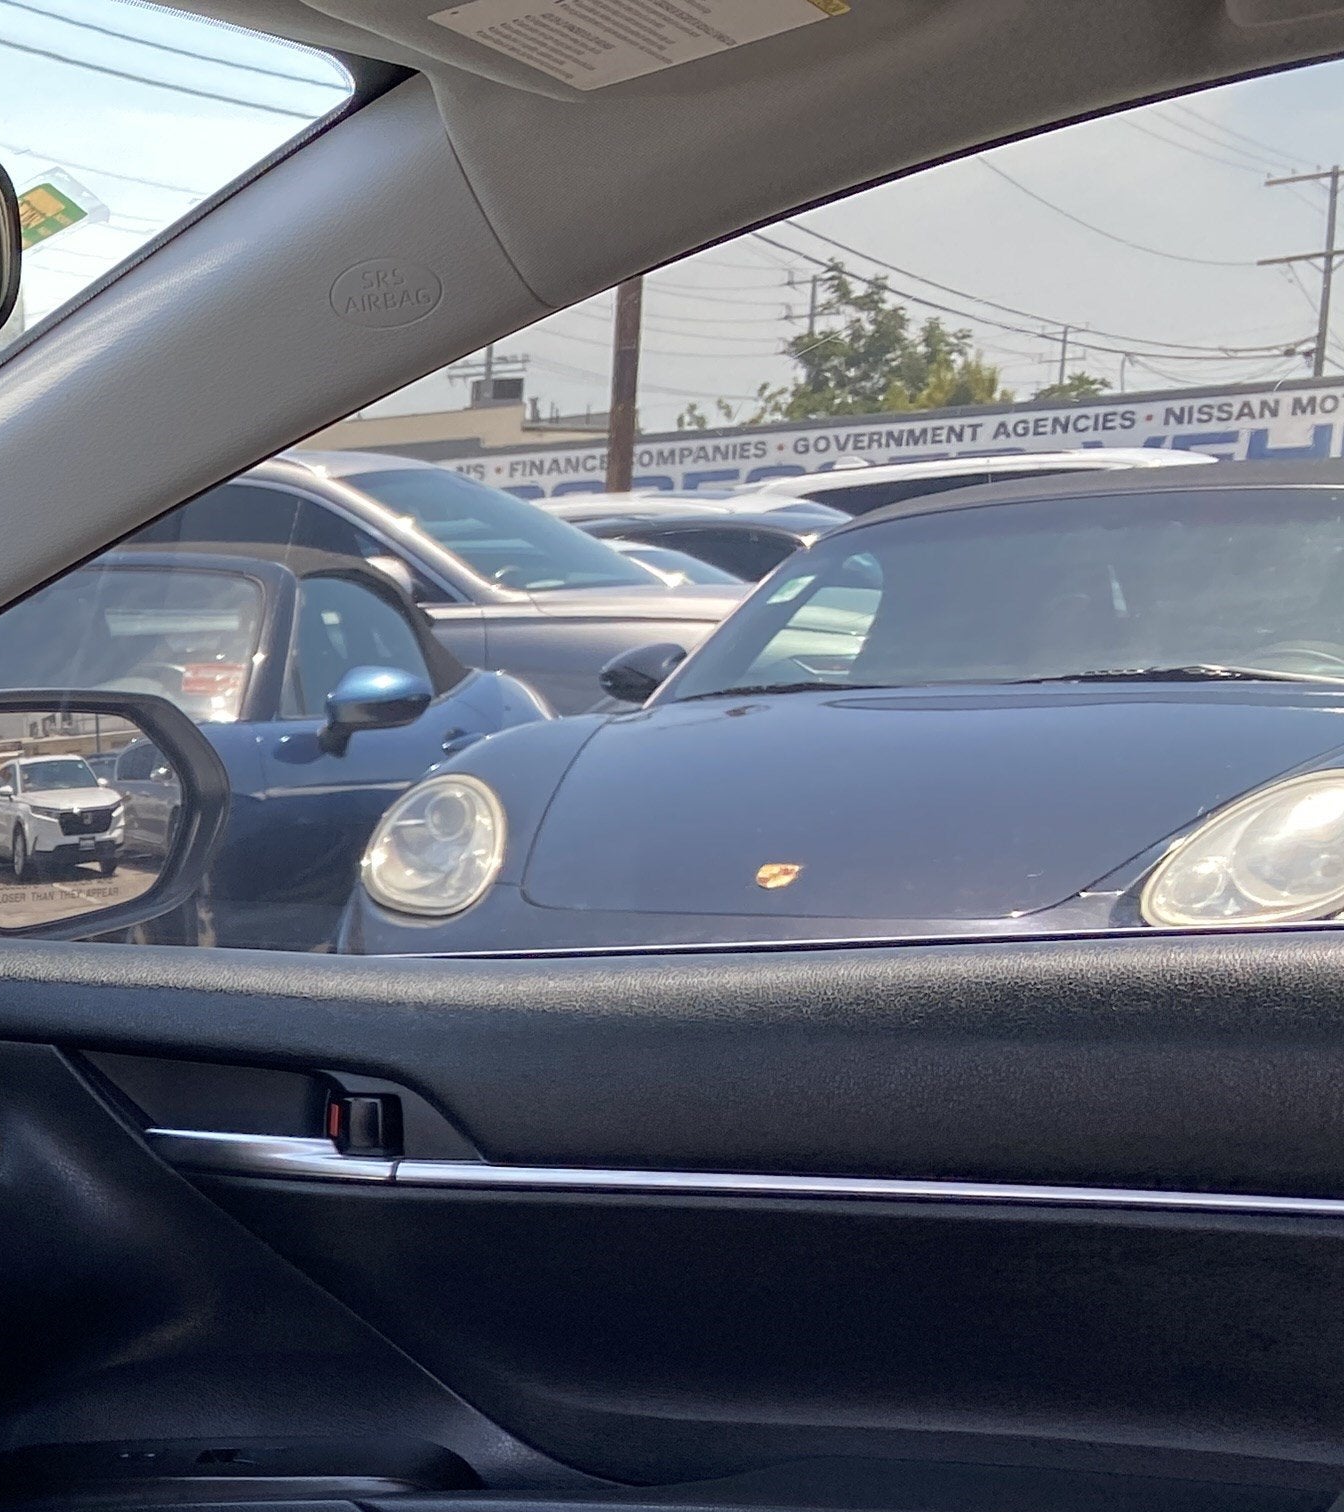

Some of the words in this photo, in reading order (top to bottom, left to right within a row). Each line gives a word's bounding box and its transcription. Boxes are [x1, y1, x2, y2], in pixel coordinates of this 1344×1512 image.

[362, 268, 406, 290] SRS
[345, 288, 431, 313] AIRBAG
[793, 422, 982, 456] GOVERNMENT
[993, 410, 1136, 438] AGENCIES
[1164, 398, 1279, 426] NISSAN
[1291, 394, 1344, 417] MO
[31, 890, 54, 902] THAN
[86, 887, 119, 898] APPEAR
